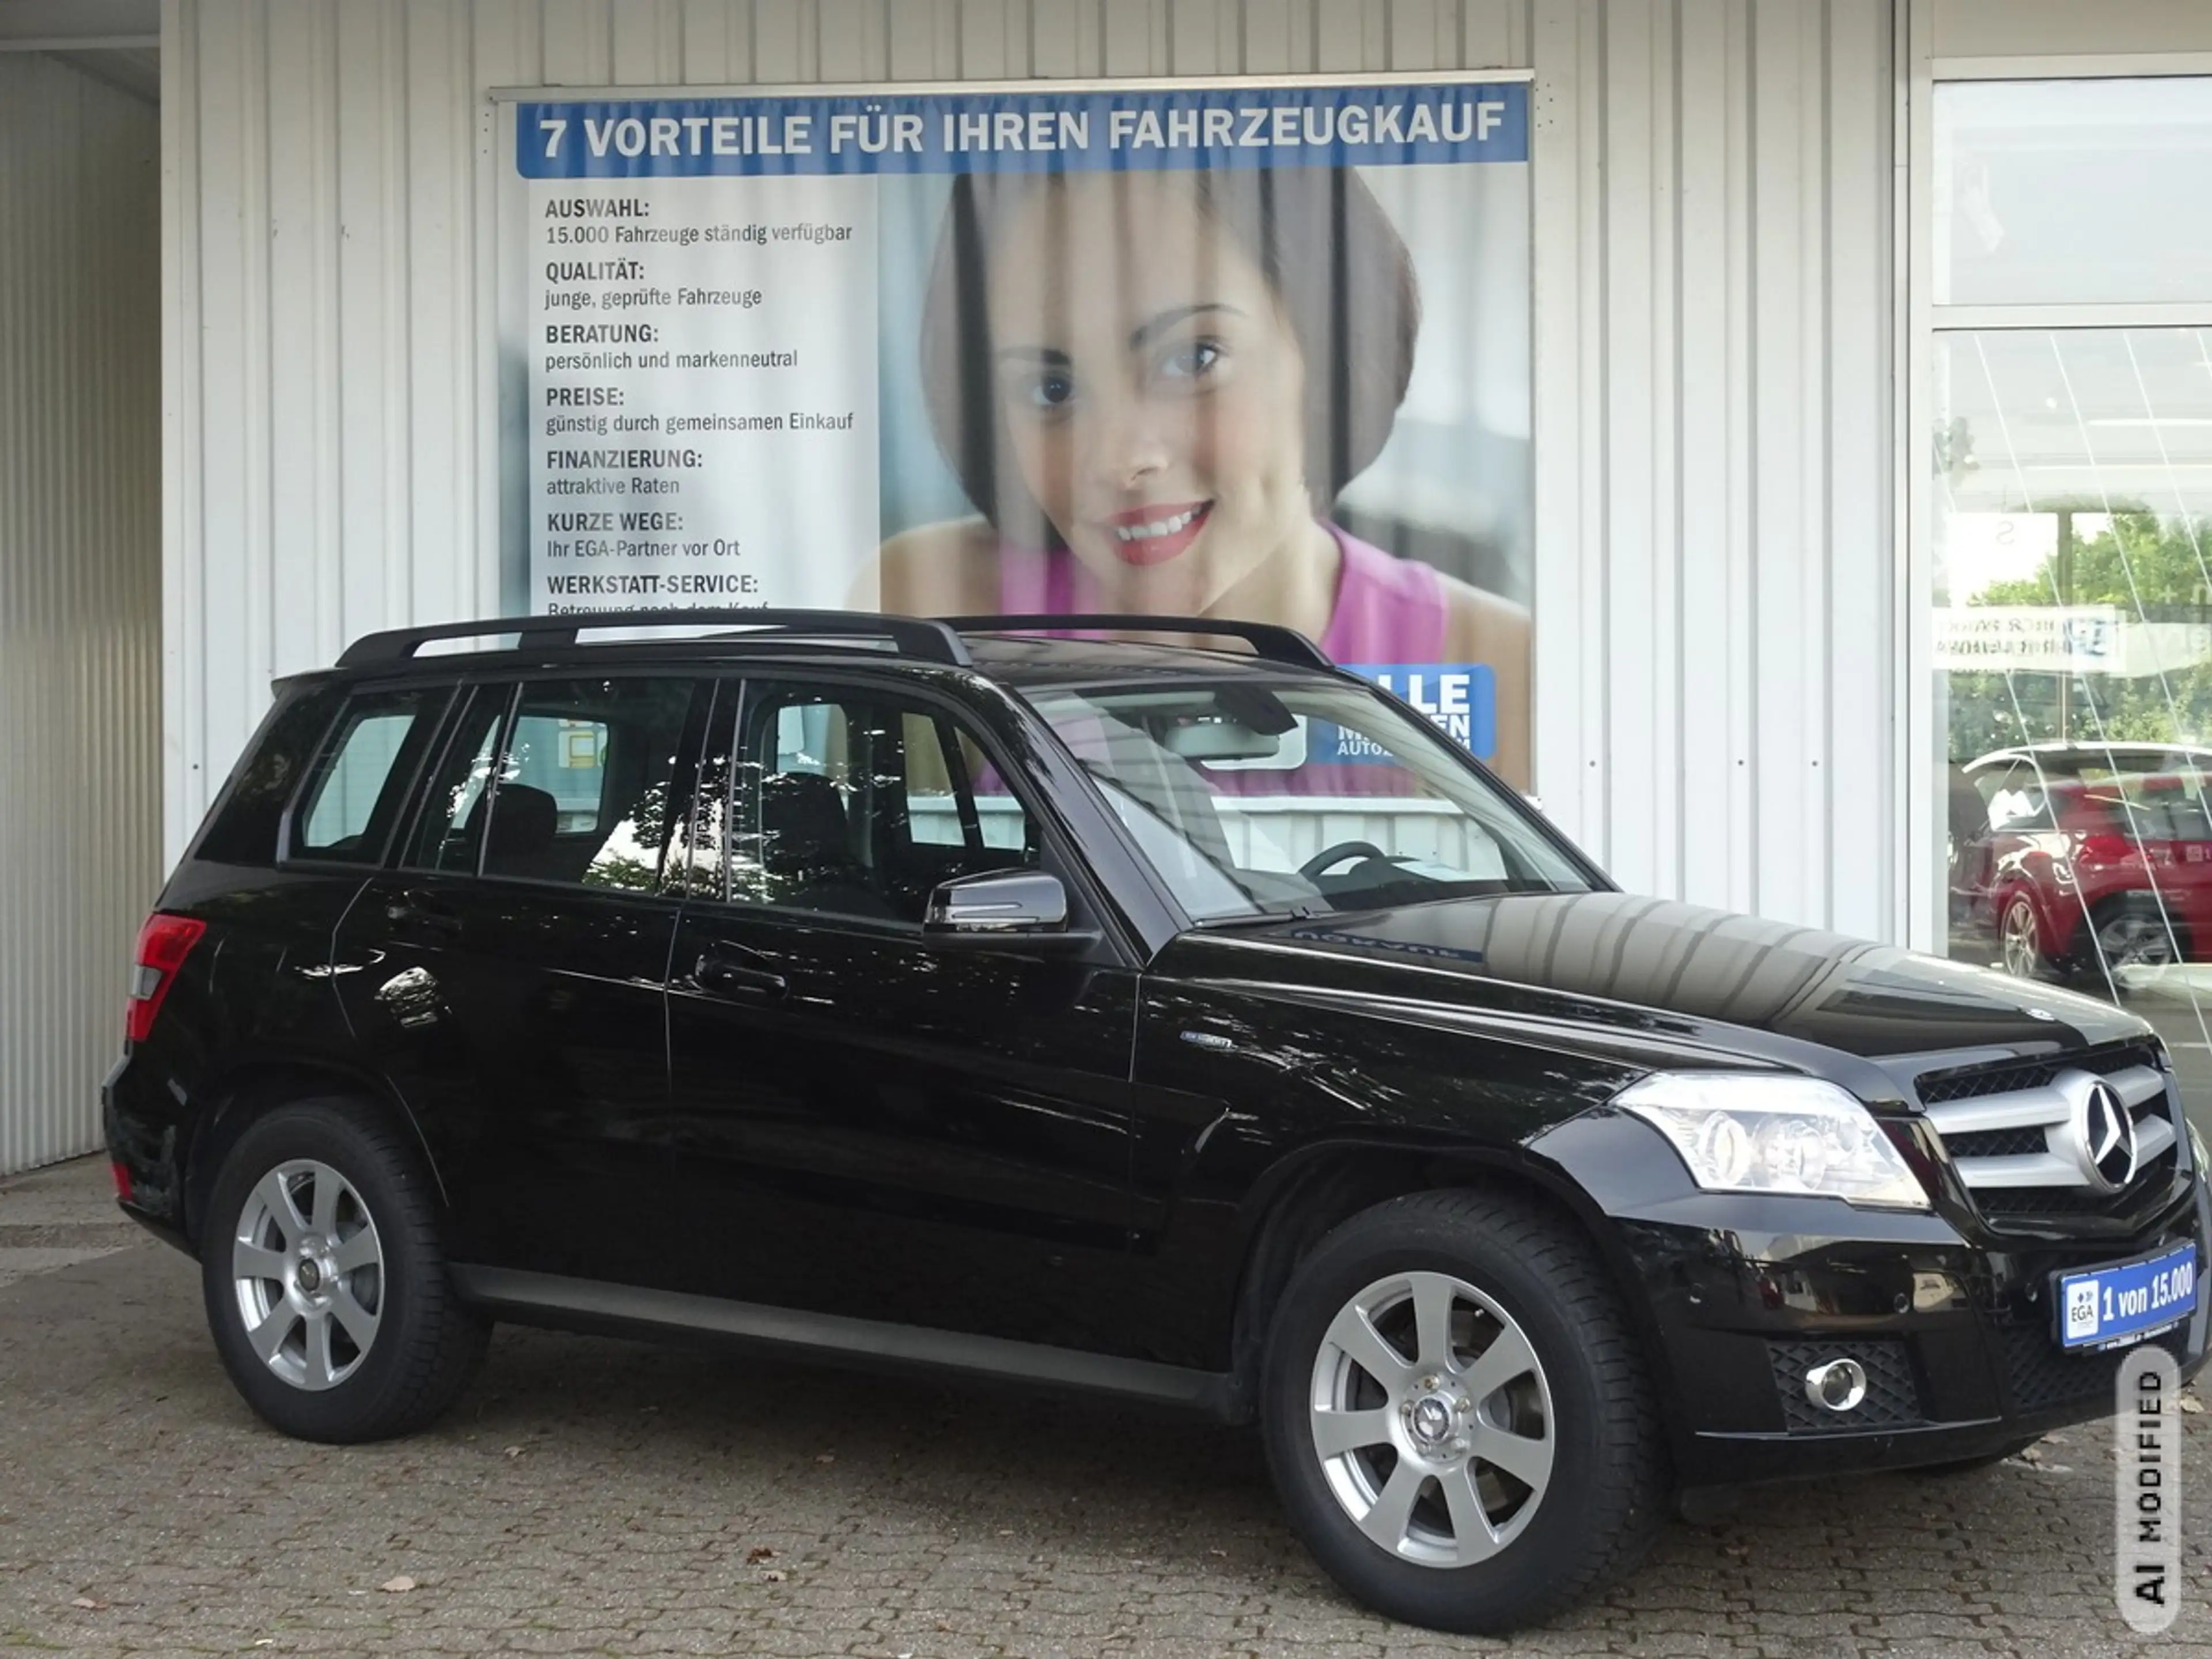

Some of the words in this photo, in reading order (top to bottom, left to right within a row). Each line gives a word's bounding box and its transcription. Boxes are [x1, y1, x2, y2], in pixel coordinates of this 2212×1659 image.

[539, 120, 567, 158] 7
[584, 115, 811, 158] VORTEILE
[831, 104, 923, 153] FÜR
[944, 111, 1088, 151] IHREN
[1109, 102, 1505, 150] FAHRZEUGKAUF
[546, 199, 649, 218] AUSWAHL:
[547, 226, 608, 244] 15.000
[615, 226, 699, 245] Fahrzeuge
[704, 224, 767, 245] ständig
[772, 223, 852, 245] verfügbar
[546, 257, 645, 283] QUALITÄT:
[544, 289, 596, 310] junge,
[601, 289, 671, 309] geprüfte
[678, 288, 762, 308] Fahrzeuge
[547, 324, 658, 343] BERATUNG:
[546, 353, 632, 372] persönlich
[639, 352, 669, 368] und
[676, 350, 797, 368] markenneutral
[547, 387, 624, 406] PREISE:
[546, 415, 607, 435] günstig
[613, 415, 658, 431] durch
[666, 414, 783, 434] gemeinsamen
[790, 412, 854, 429] Einkauf
[547, 450, 702, 469] FINANZIERUNG:
[547, 478, 625, 494] attraktive
[632, 478, 679, 494] Raten
[548, 513, 613, 531] KURZE
[620, 513, 683, 531] WEGE:
[548, 540, 569, 557] Ihr
[575, 540, 676, 557] EGA-Partner
[683, 544, 707, 556] vor
[714, 539, 740, 556] Ort
[548, 575, 757, 594] WERKSTATT-SERVICE:
[2103, 1286, 2115, 1321] 1
[2118, 1286, 2147, 1317] von
[2151, 1261, 2192, 1309] 15.000
[2071, 1305, 2094, 1322] EGA
